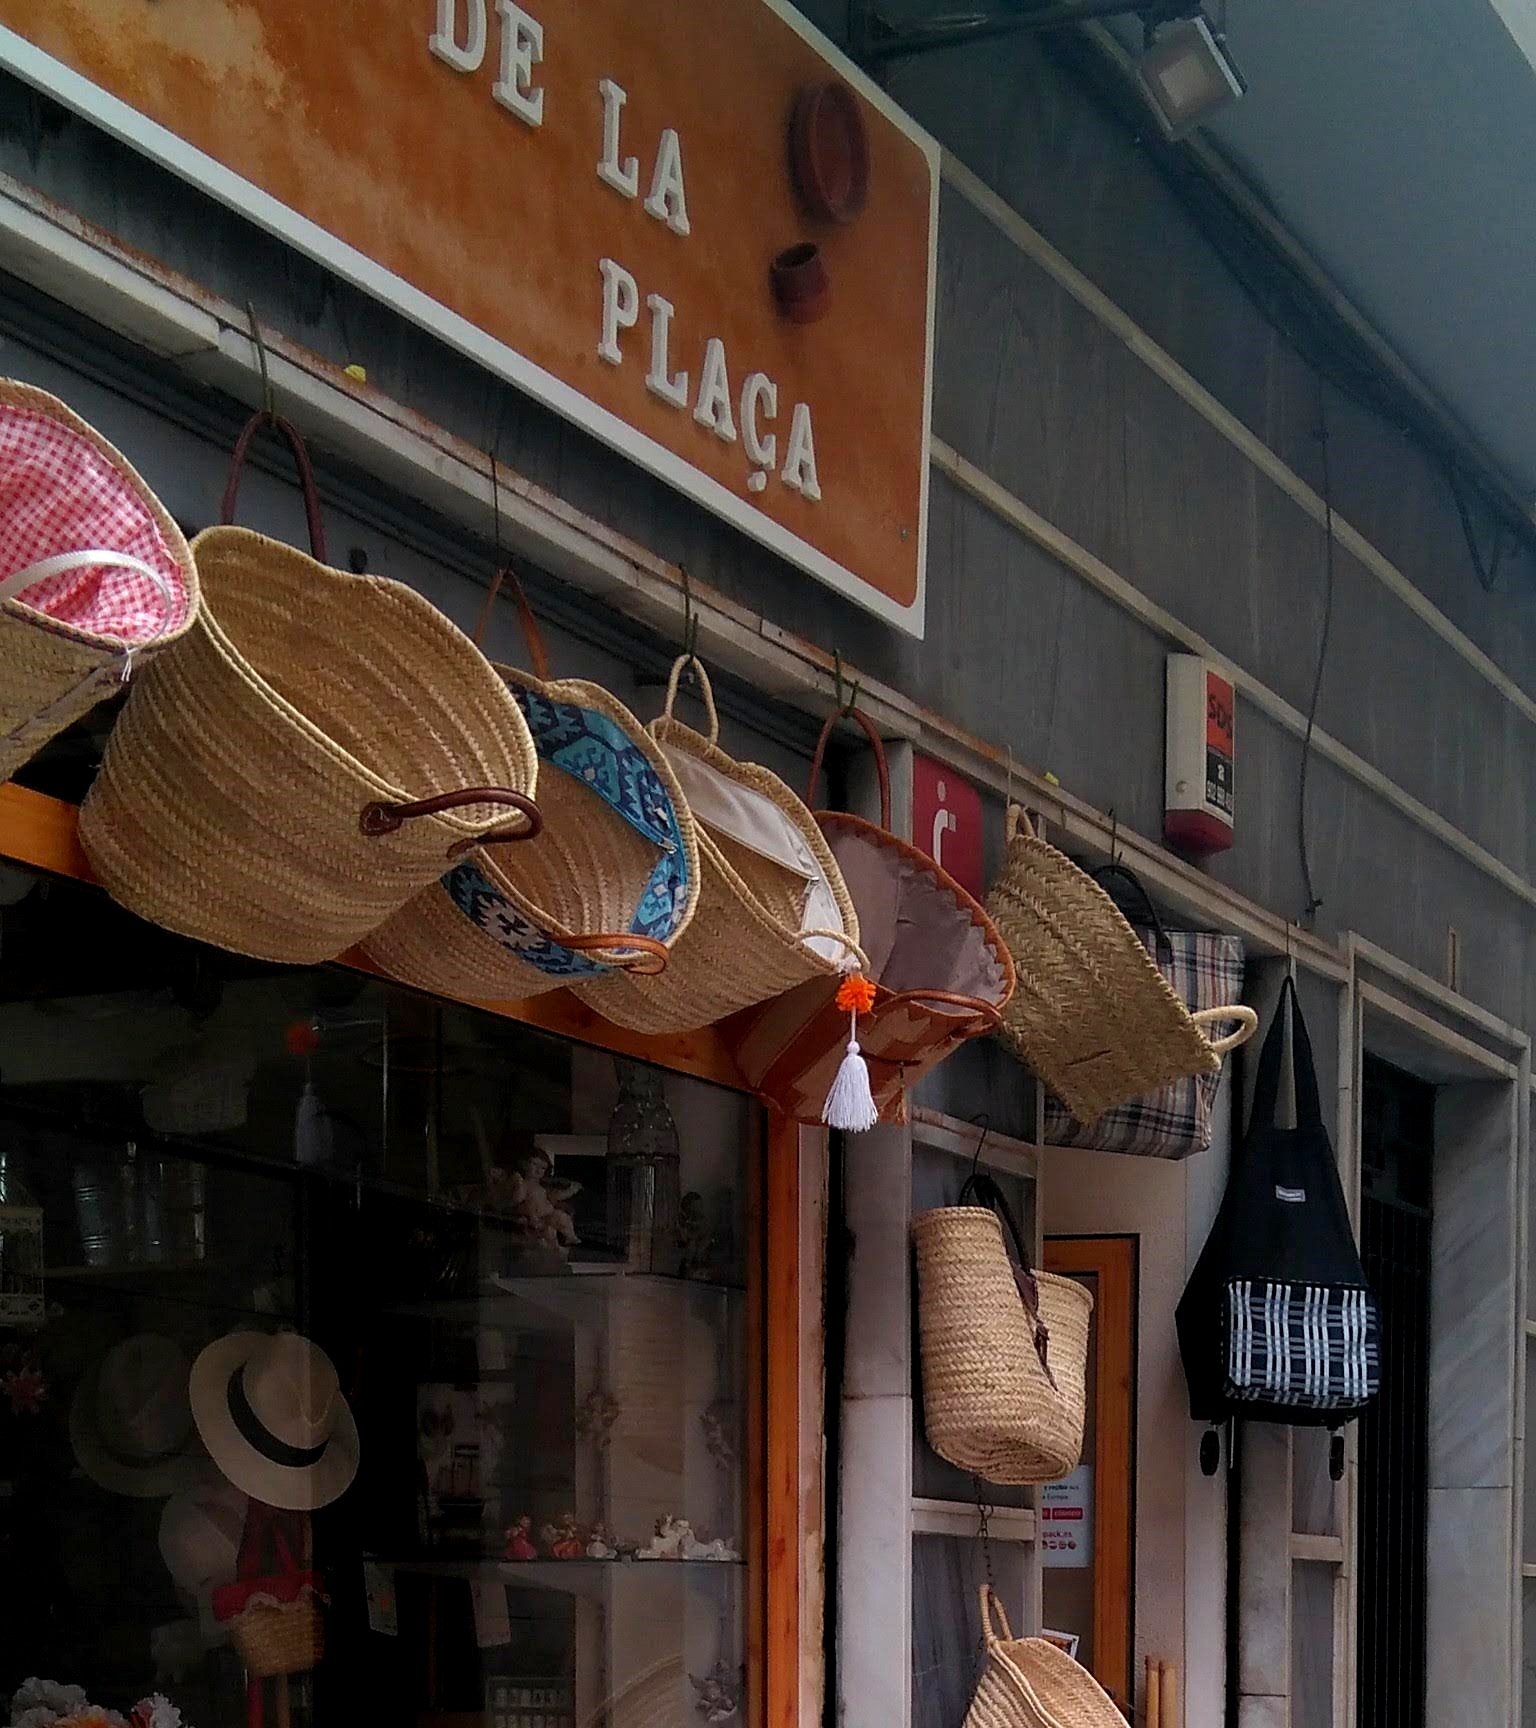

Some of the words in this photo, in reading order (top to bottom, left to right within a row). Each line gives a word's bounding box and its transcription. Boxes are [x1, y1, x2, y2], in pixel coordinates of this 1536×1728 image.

[429, 0, 544, 127] DE
[597, 78, 691, 237] LA
[598, 257, 823, 501] PLAÇA
